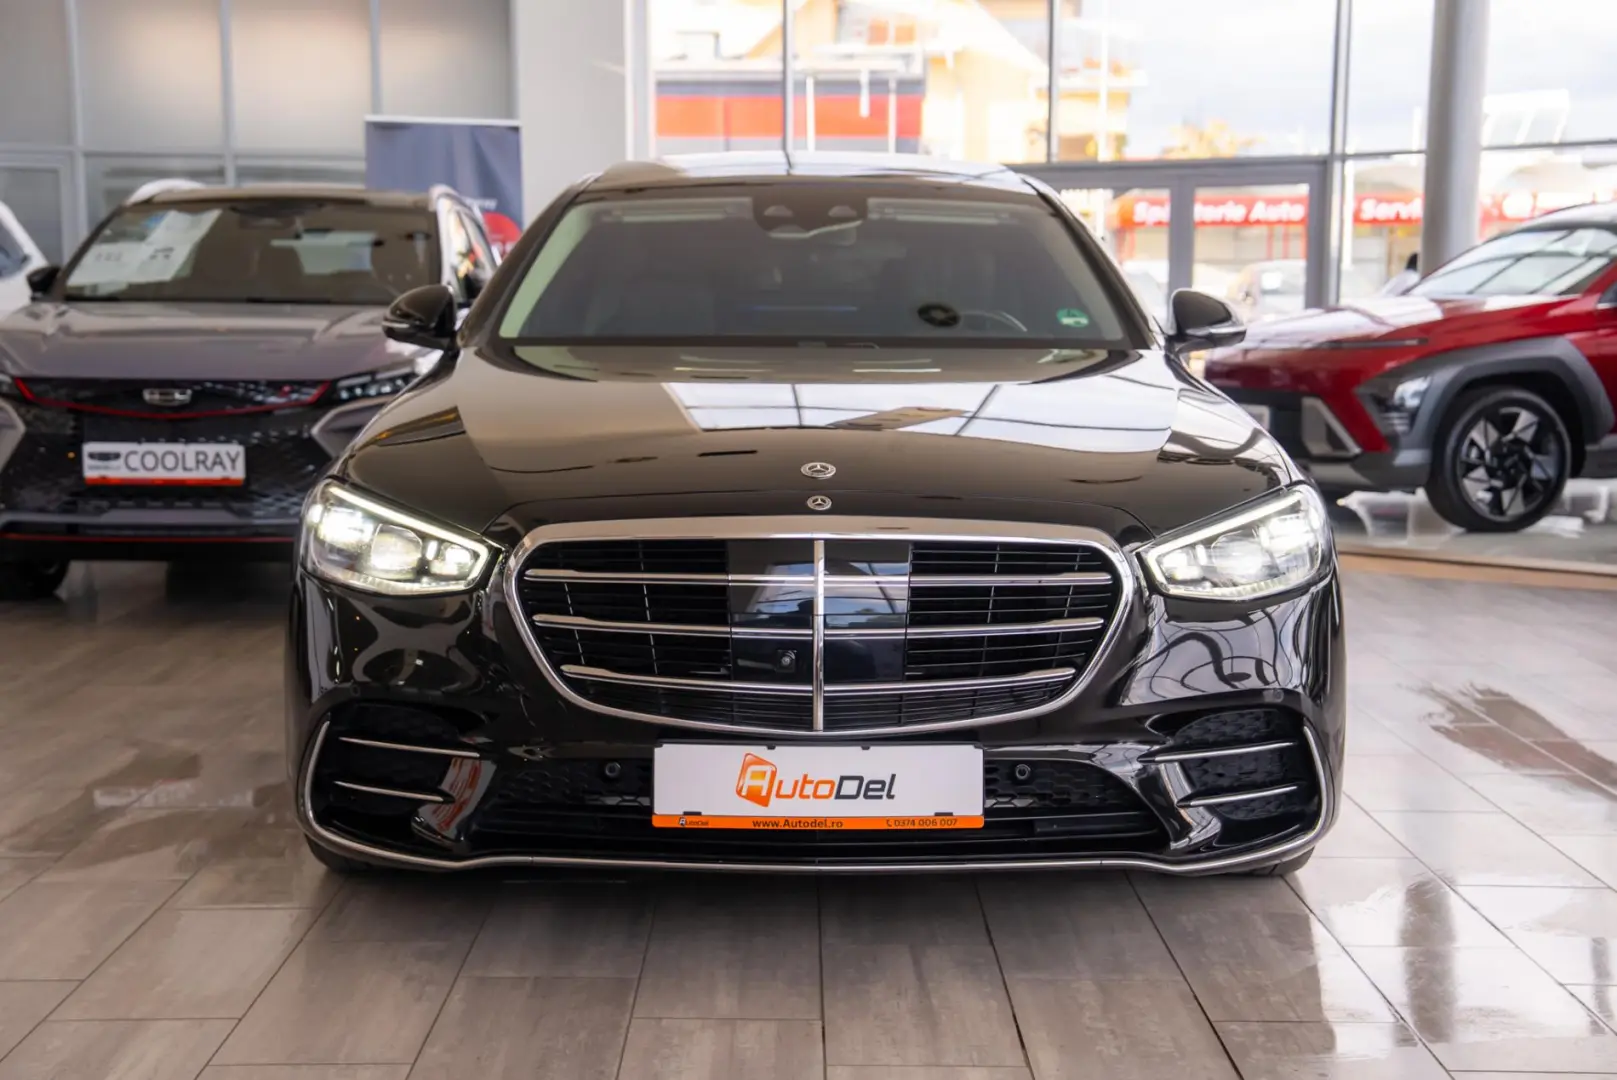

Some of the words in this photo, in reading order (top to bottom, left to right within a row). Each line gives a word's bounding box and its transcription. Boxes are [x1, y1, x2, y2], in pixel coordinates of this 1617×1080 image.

[1248, 200, 1306, 222] Auto
[1360, 198, 1423, 220] Servi
[125, 450, 240, 471] COOLRAY
[738, 762, 897, 801] AutoDel
[752, 818, 843, 829] www.Autodel.ro
[894, 818, 916, 827] 0374
[918, 818, 938, 827] 006
[939, 818, 958, 827] 007
